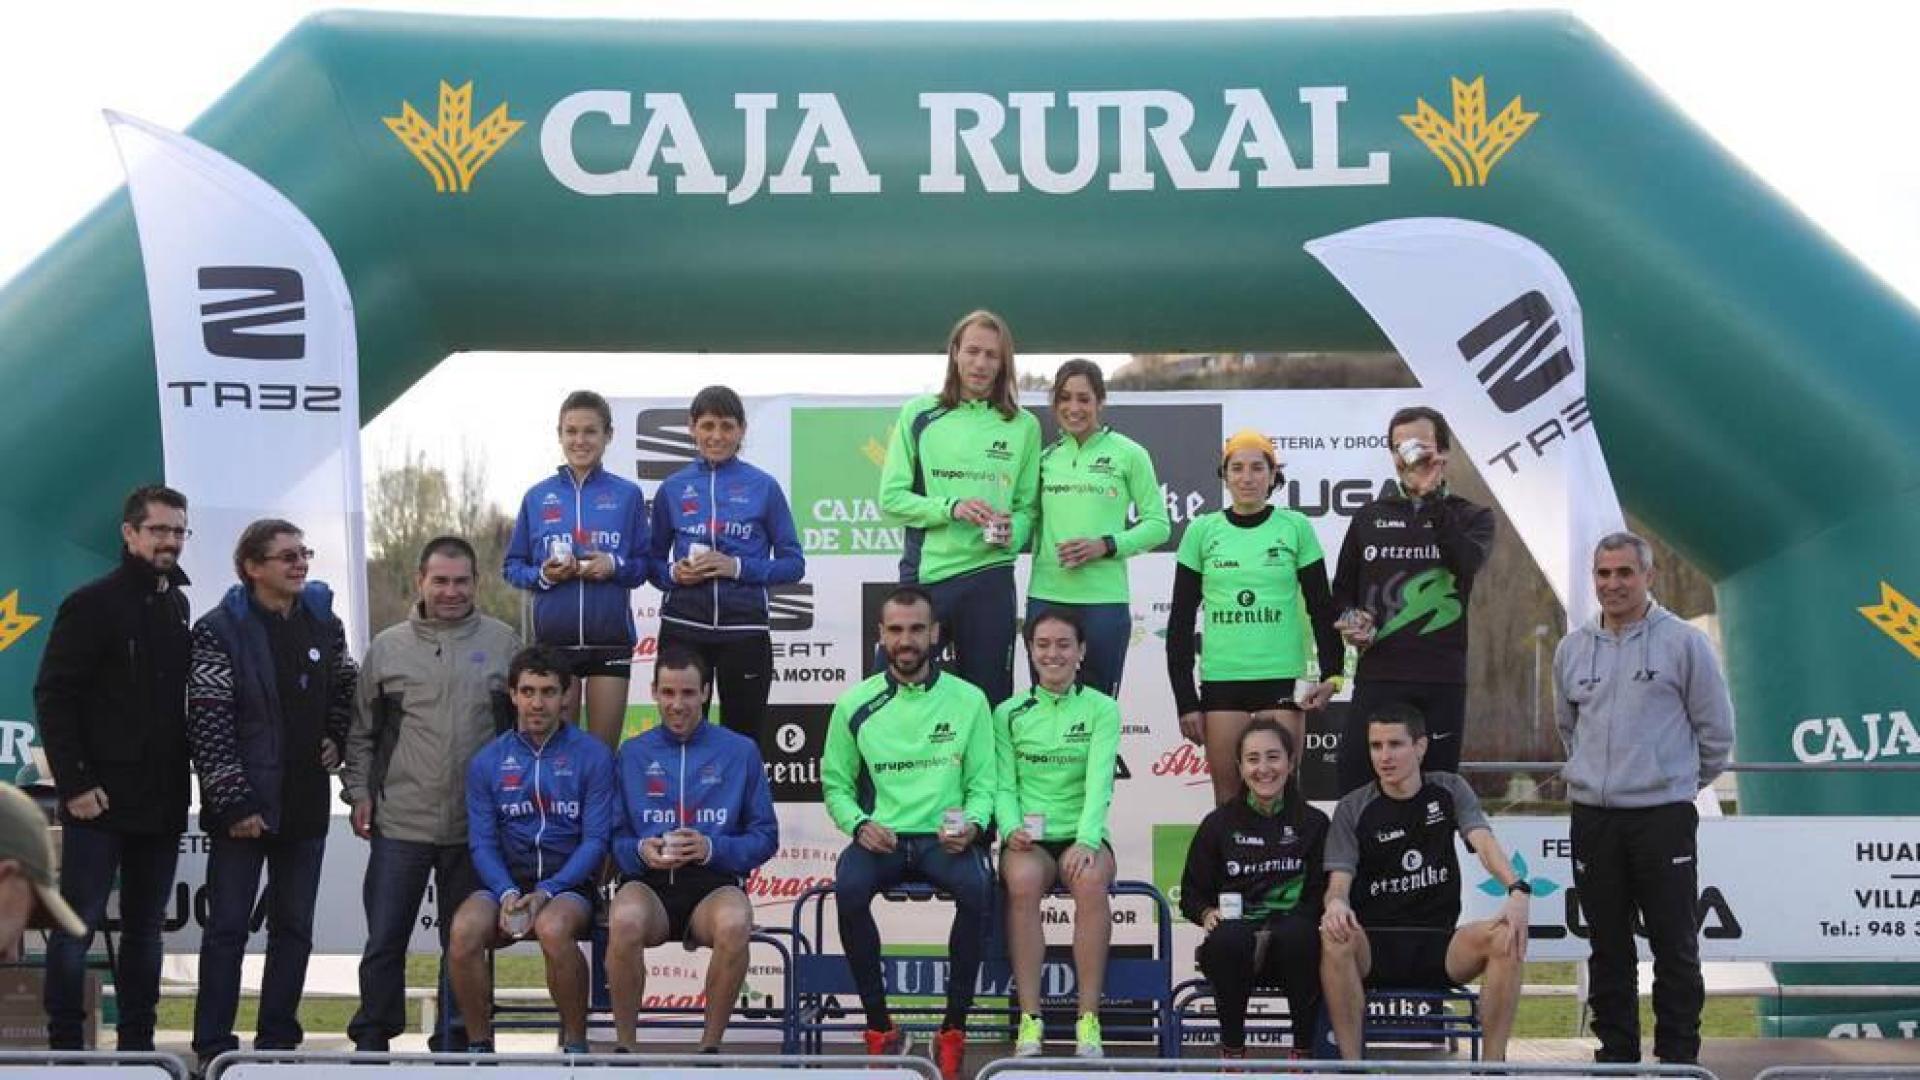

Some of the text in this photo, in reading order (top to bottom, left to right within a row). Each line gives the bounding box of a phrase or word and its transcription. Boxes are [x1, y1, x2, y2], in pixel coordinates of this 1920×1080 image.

[540, 86, 1391, 205] CAJA RURAL
[1269, 436, 1325, 450] ETERIA
[1330, 437, 1340, 450] Y
[812, 499, 882, 523] CAJA
[803, 527, 906, 549] DE NAV
[771, 642, 834, 659] EAT
[782, 668, 847, 682] MOTOR
[1791, 710, 1920, 763] CAJA
[1543, 839, 1571, 858] FE
[1856, 841, 1920, 862] HUA
[1819, 919, 1861, 937] Tel.:
[1867, 920, 1906, 937] 948
[1367, 998, 1431, 1017] nike
